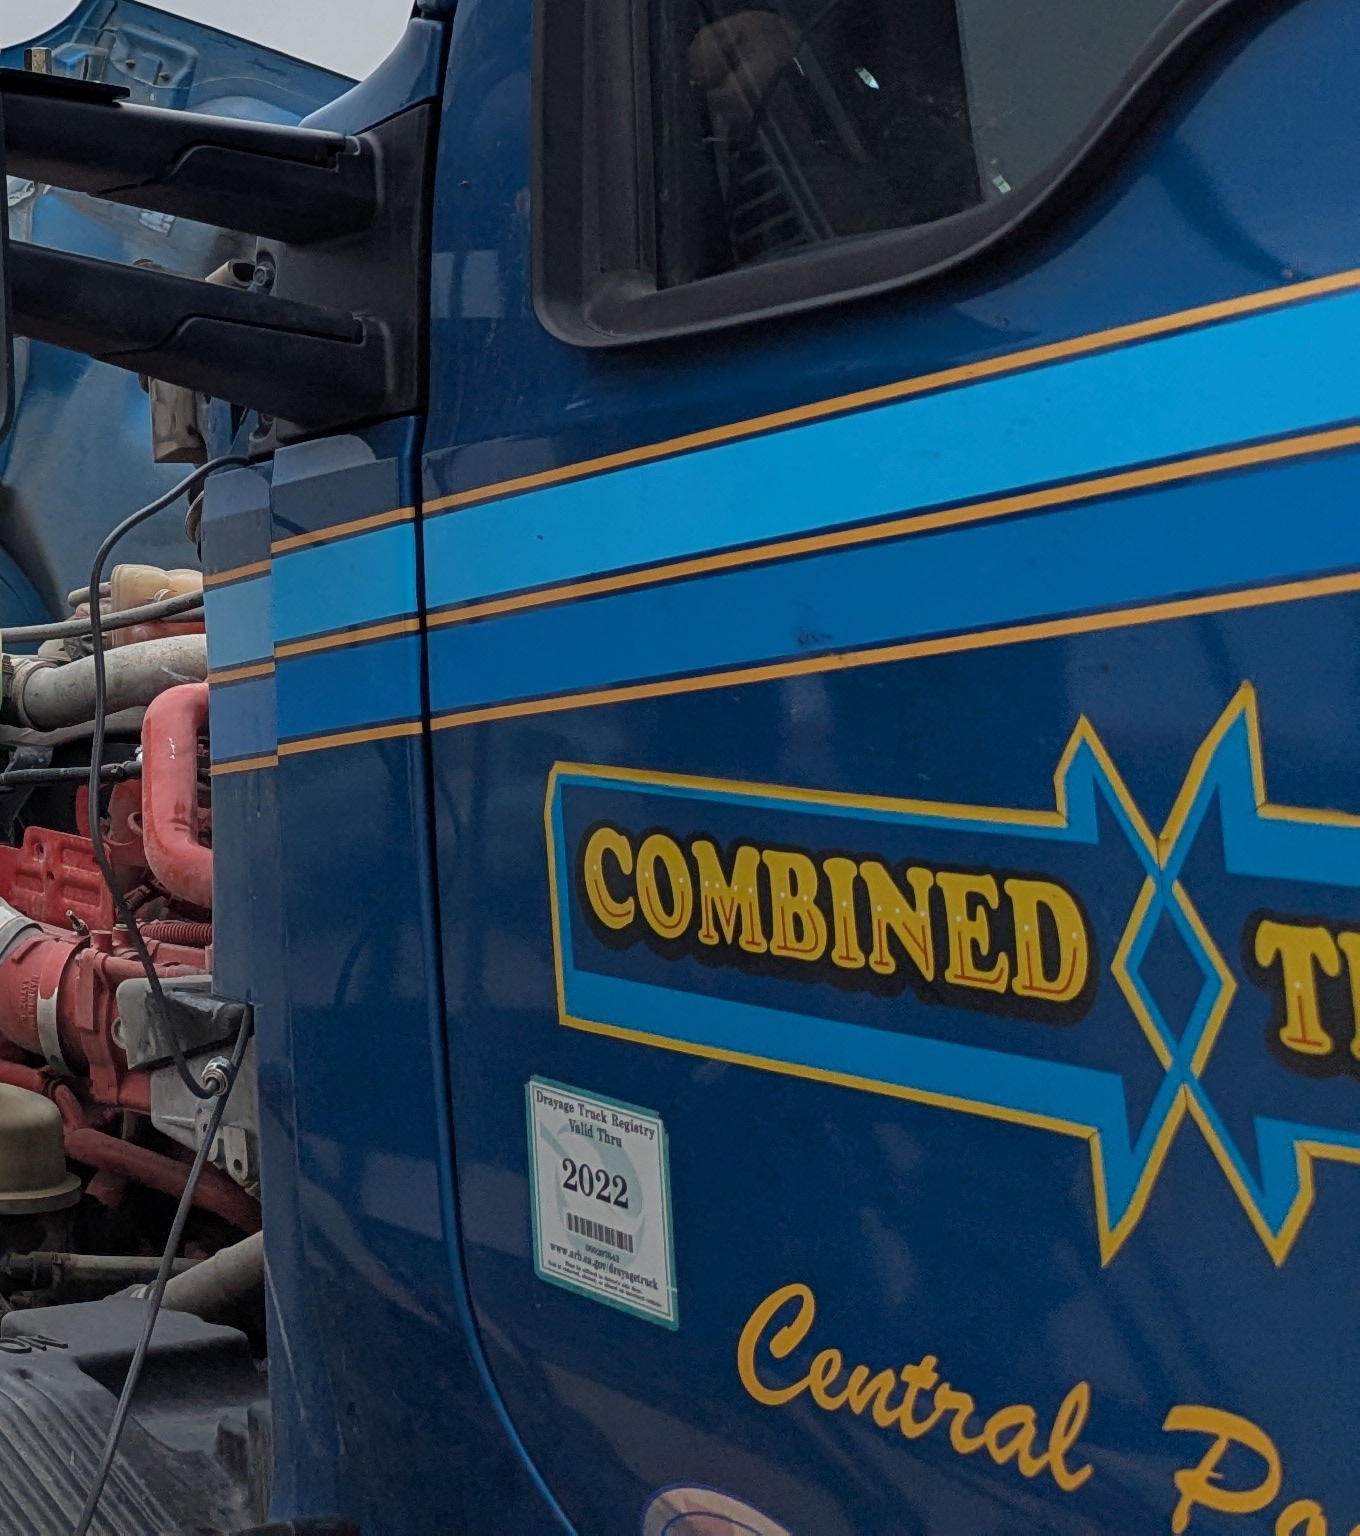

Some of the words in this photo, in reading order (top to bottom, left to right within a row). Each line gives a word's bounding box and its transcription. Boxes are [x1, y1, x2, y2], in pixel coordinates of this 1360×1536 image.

[584, 826, 1088, 1002] COMBINED
[536, 1089, 574, 1113] Drayage
[578, 1102, 607, 1124] Truck
[611, 1113, 656, 1141] Registry
[568, 1118, 594, 1139] Valid
[596, 1127, 623, 1148] Thru
[562, 1157, 629, 1210] 2022
[737, 1282, 1094, 1492] Central
